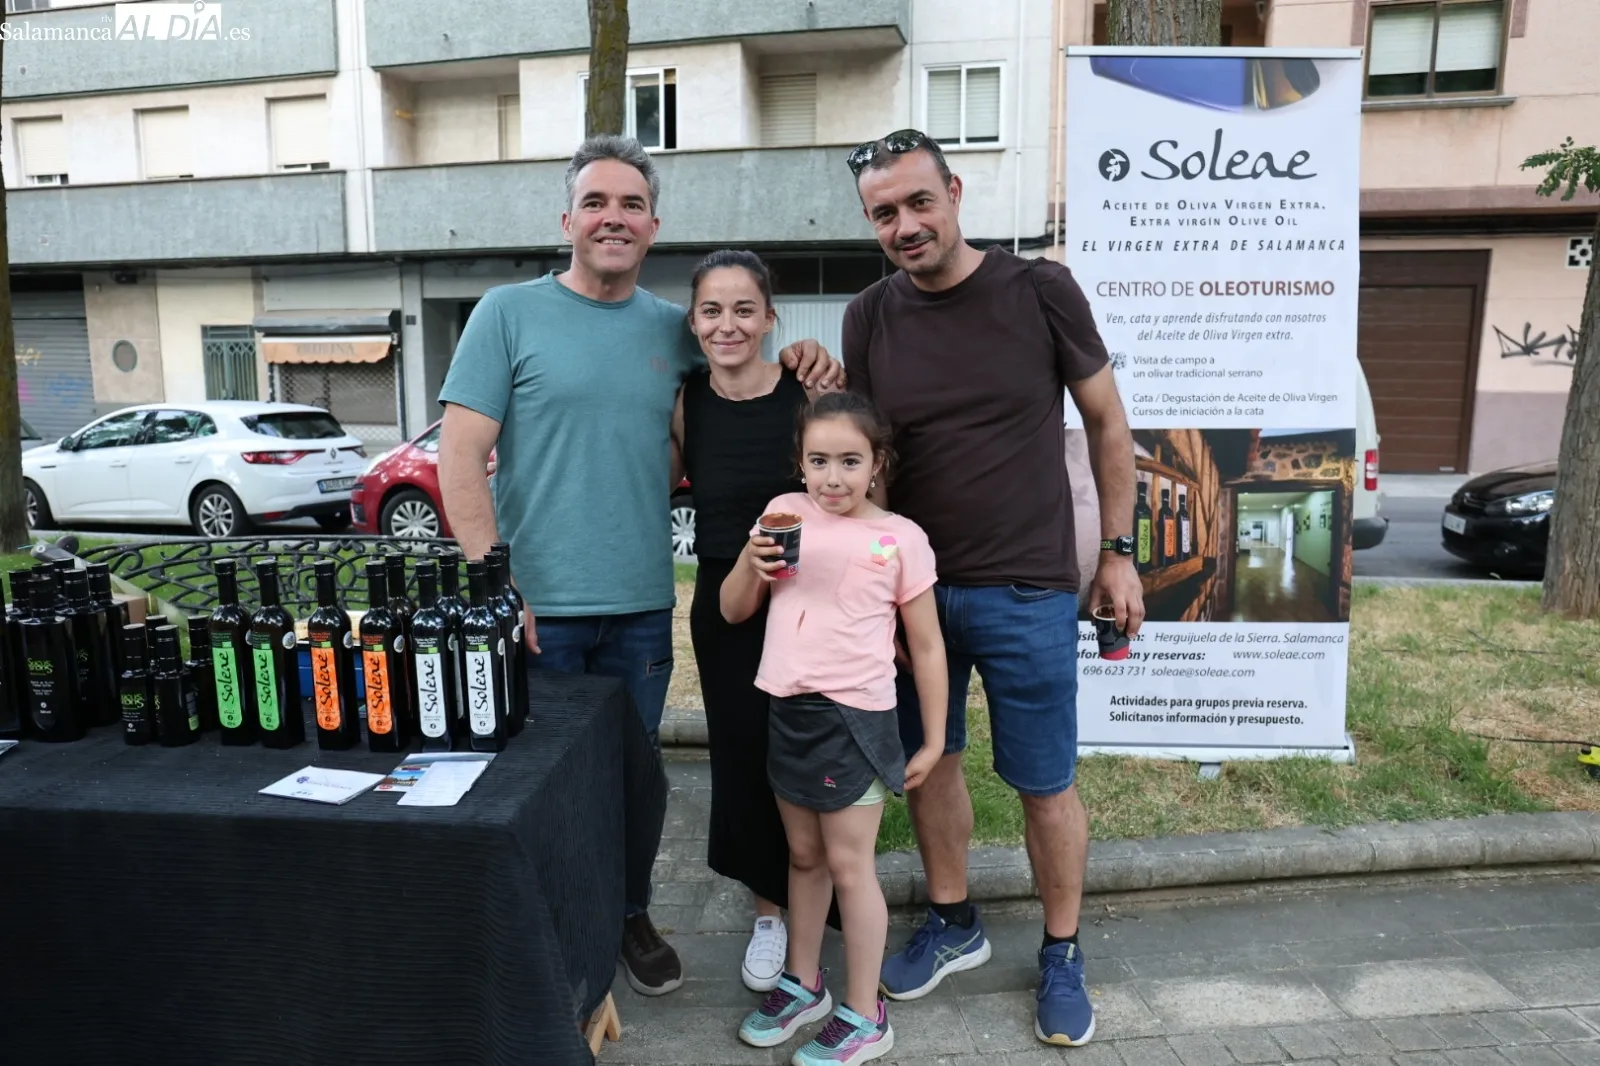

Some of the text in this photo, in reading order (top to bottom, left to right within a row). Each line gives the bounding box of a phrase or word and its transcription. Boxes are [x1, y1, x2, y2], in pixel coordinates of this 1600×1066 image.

[1141, 128, 1317, 181] Soleae
[1082, 240, 1344, 251] EL VIRGEN EXTRA DE SALAMANCA
[1096, 281, 1334, 297] CENTRO DE OLEOTURISMO
[1107, 313, 1126, 325] Ven,
[1130, 314, 1151, 323] cata
[1153, 316, 1160, 326] y
[1163, 312, 1202, 325] aprende
[1205, 312, 1262, 323] disfrutando
[1285, 313, 1326, 323] nosotros
[1137, 329, 1293, 343] del Aceite de Oliva Virgen extra.
[1133, 356, 1159, 365] Visita
[1160, 356, 1173, 364] de
[1175, 358, 1207, 368] campo
[1148, 369, 1173, 378] olivar
[1176, 368, 1225, 378] tradicional
[1133, 393, 1153, 402] Cata
[1162, 394, 1221, 404] Degustación
[1223, 393, 1235, 402] de
[1237, 393, 1266, 402] Aceite
[1269, 393, 1280, 402] de
[1283, 393, 1306, 402] Oliva
[1308, 393, 1337, 403] Virgen
[1132, 407, 1164, 416] Cursos
[1165, 407, 1178, 416] de
[1180, 407, 1224, 416] iniciación
[1234, 406, 1242, 415] la
[1155, 632, 1217, 645] Herguijuela
[1219, 633, 1232, 642] de
[1234, 633, 1245, 642] la
[1247, 633, 1280, 643] Sierra.
[1283, 633, 1344, 643] Salamanca
[1143, 653, 1150, 662] y
[1233, 649, 1325, 659] www.soleae.com
[217, 651, 234, 704] Soleae
[1083, 665, 1255, 678] 696 623 731 soleae@soleae.com
[257, 652, 273, 707] Soleae
[316, 652, 333, 707] Soleae
[367, 656, 385, 711] Soleae
[420, 658, 439, 714] Soleae
[470, 656, 489, 712] Soleae
[1110, 696, 1307, 710] Actividades para grupos previa reserva.
[1166, 712, 1227, 723] información
[1229, 716, 1236, 726] y
[1237, 715, 1303, 726] presupuesto.
